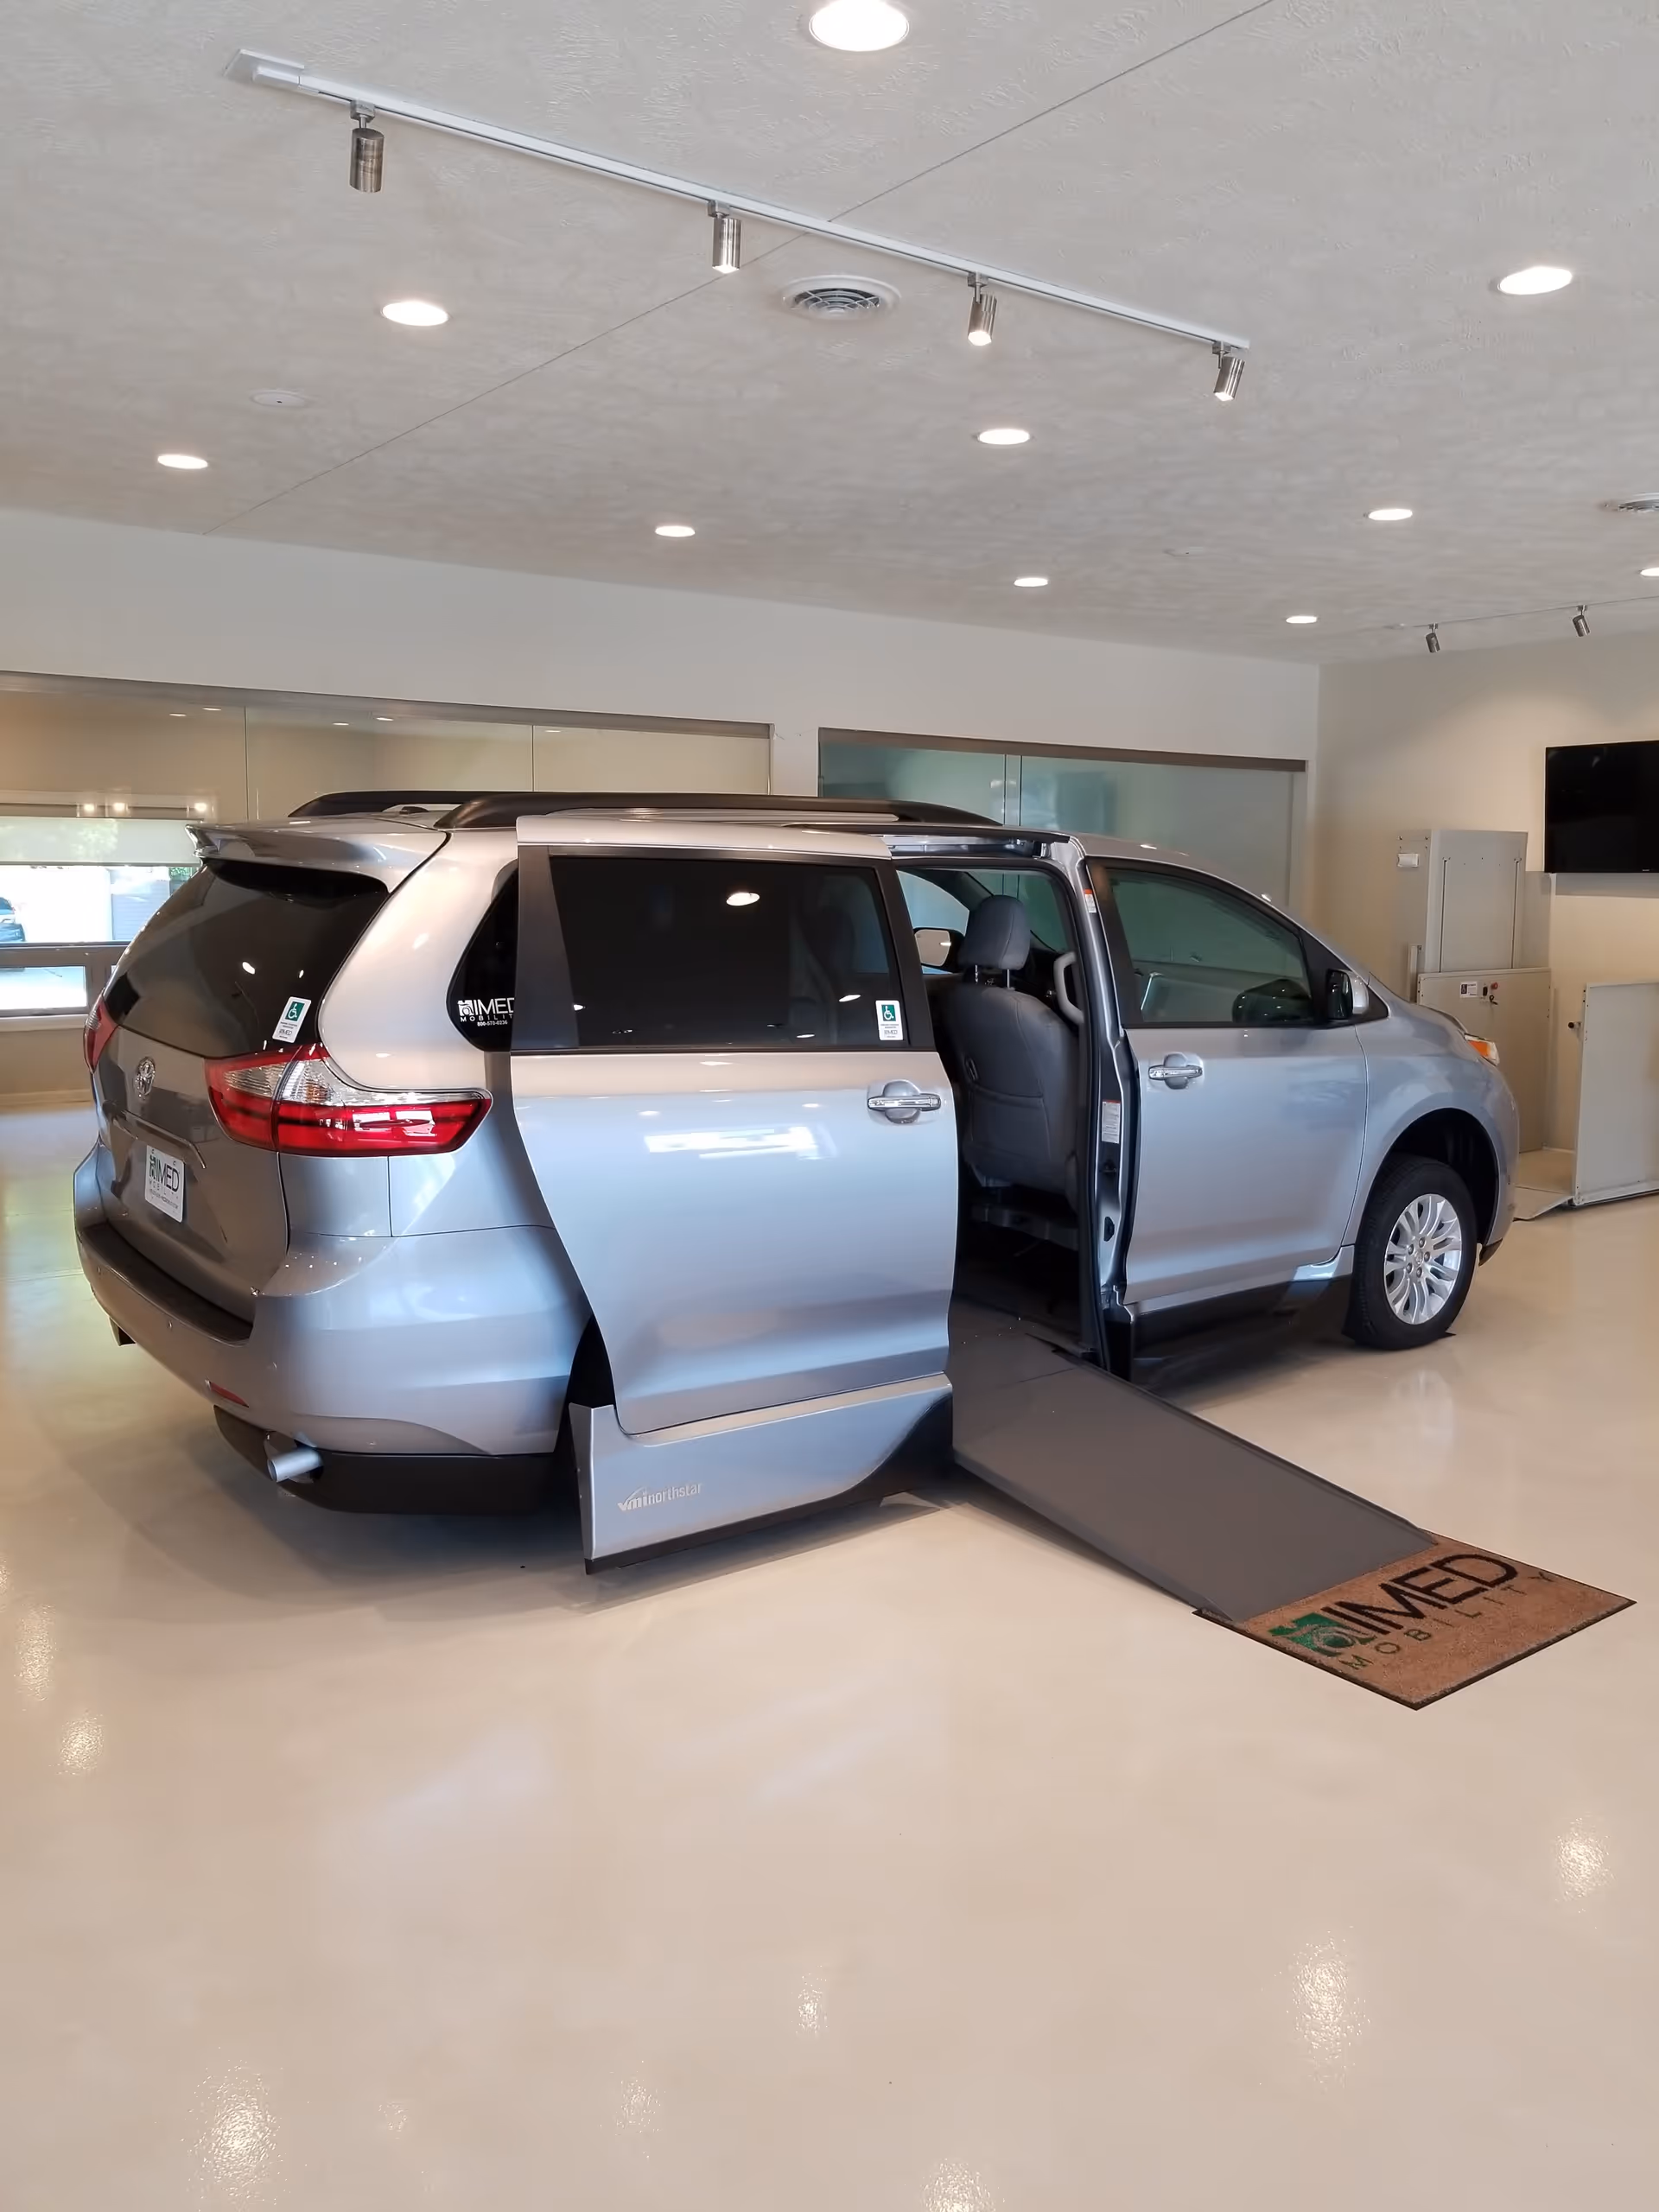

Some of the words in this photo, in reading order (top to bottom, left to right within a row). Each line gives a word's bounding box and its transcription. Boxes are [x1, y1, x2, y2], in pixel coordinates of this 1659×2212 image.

[461, 1014, 513, 1022] MOBILIT
[1320, 1553, 1518, 1635] IMED
[1340, 1571, 1558, 1670] MOBILITY
